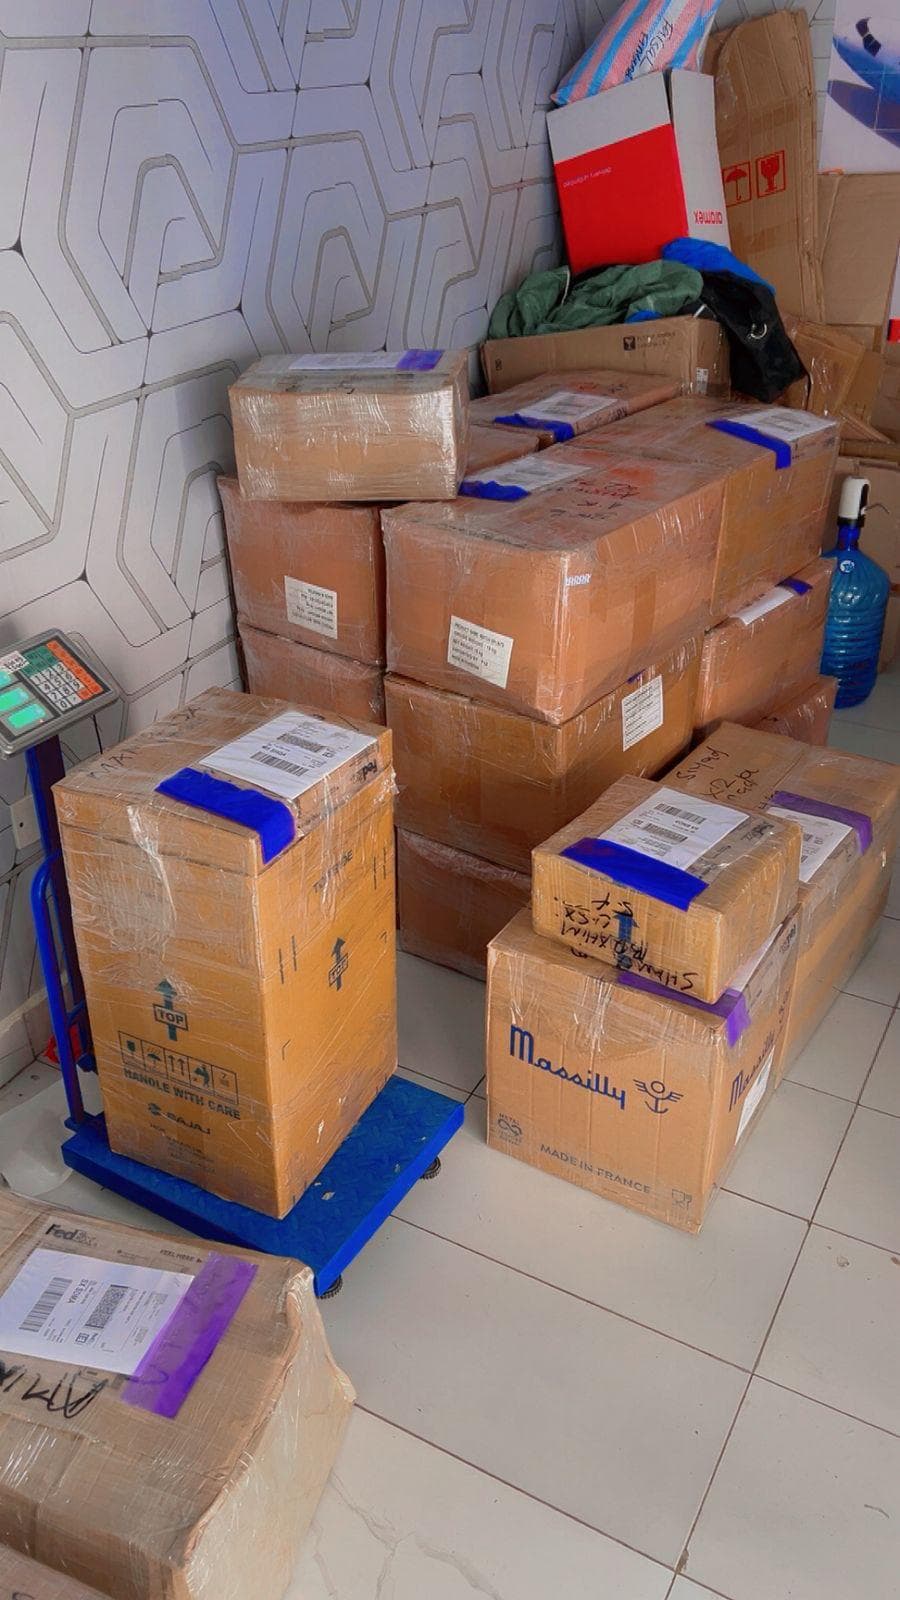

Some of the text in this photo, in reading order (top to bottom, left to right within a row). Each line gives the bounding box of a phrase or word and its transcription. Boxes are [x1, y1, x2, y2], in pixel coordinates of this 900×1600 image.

[158, 1009, 185, 1025] TOP
[509, 1023, 626, 1110] Massilly
[124, 1068, 170, 1094] HANDLE
[173, 1086, 205, 1106] WITH
[208, 1100, 241, 1121] CARE
[540, 1143, 652, 1194] MADE IN FRANCE
[45, 1222, 98, 1248] FedEx
